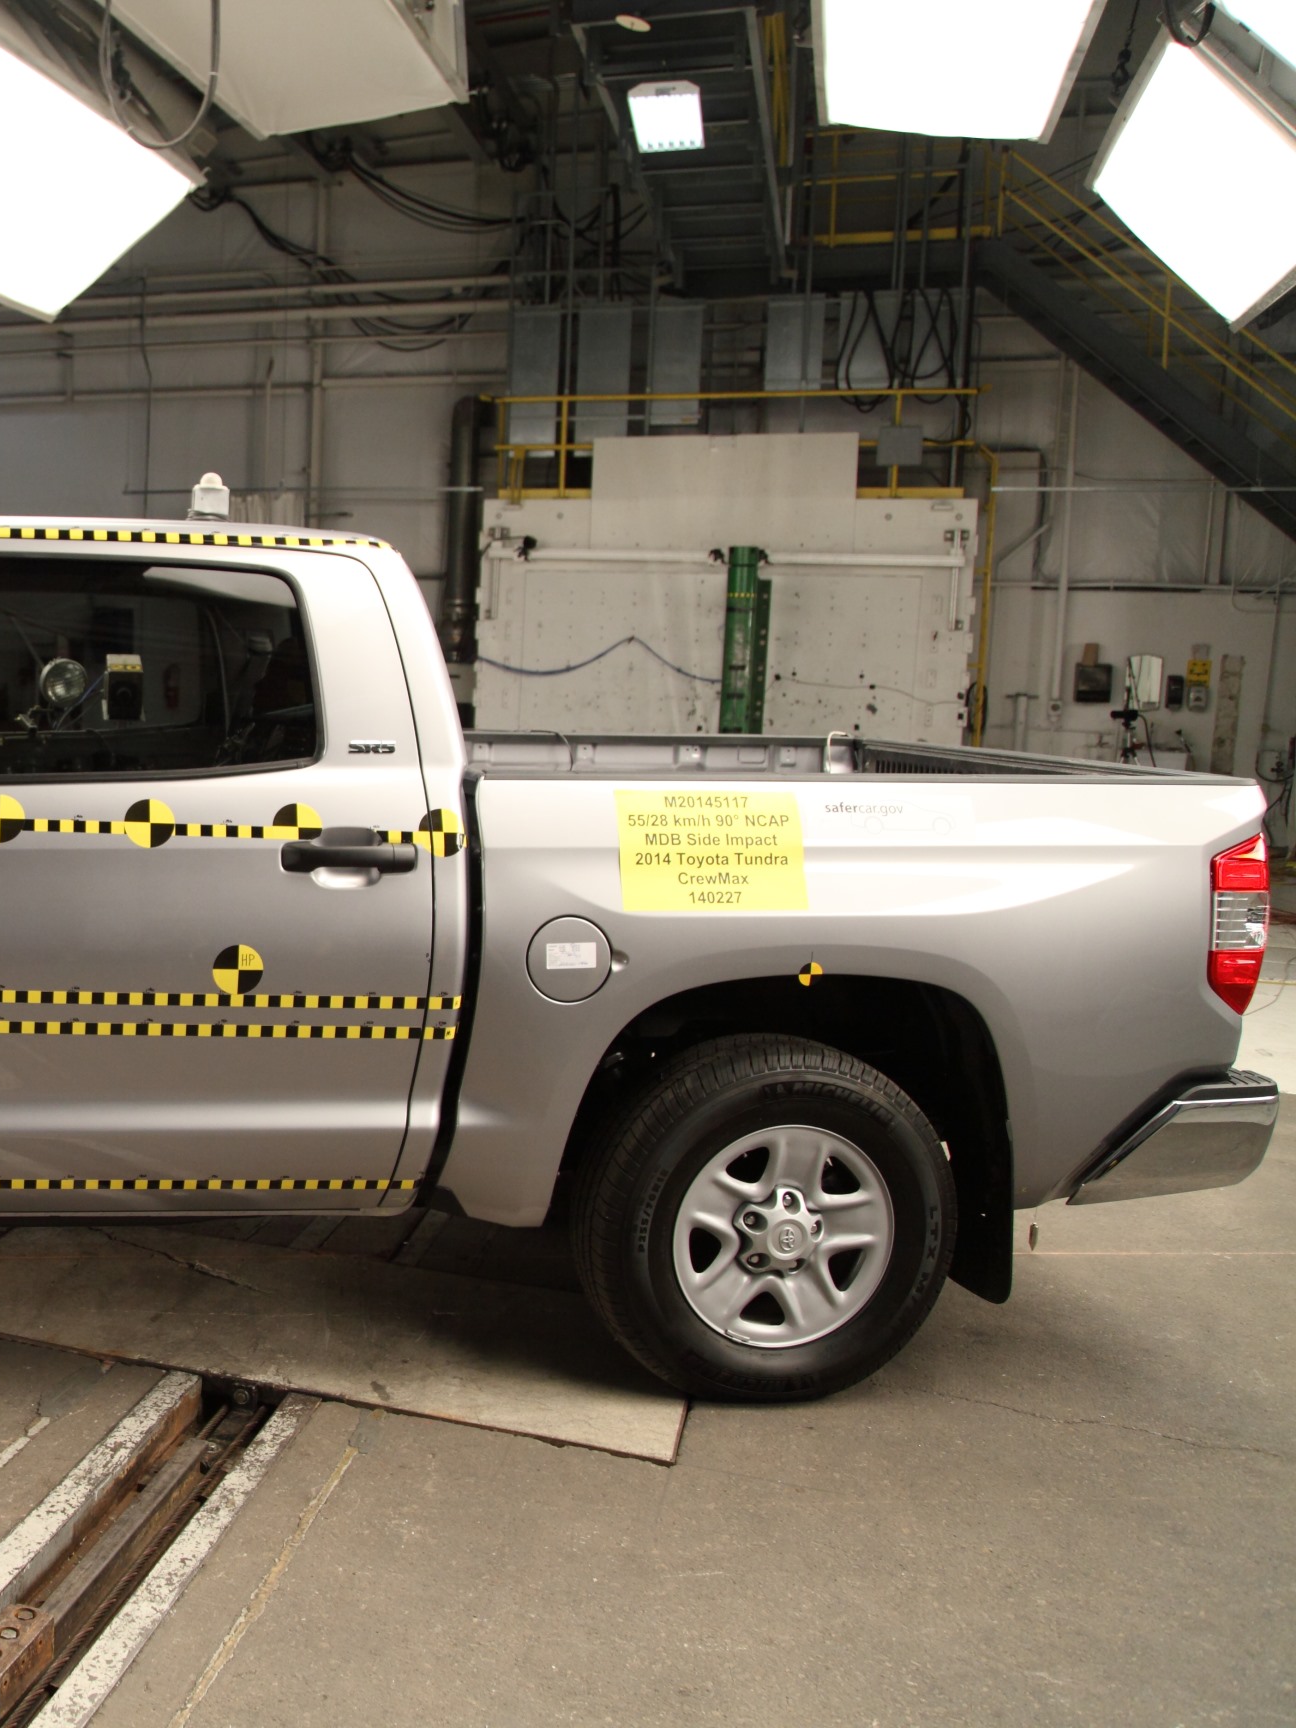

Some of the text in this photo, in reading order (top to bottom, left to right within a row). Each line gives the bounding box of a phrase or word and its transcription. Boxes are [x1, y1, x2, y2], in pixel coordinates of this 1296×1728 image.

[664, 796, 748, 808] M20145117
[824, 801, 904, 817] safercar.gov
[628, 814, 668, 827] 55/28
[674, 814, 711, 827] km/h
[745, 814, 790, 827] NCAP
[645, 833, 778, 849] MDB Side Impact
[635, 852, 789, 868] 2014 Toyota Tundra
[678, 872, 749, 885] CrewMax
[689, 891, 742, 904] 140227
[241, 953, 256, 967] HP
